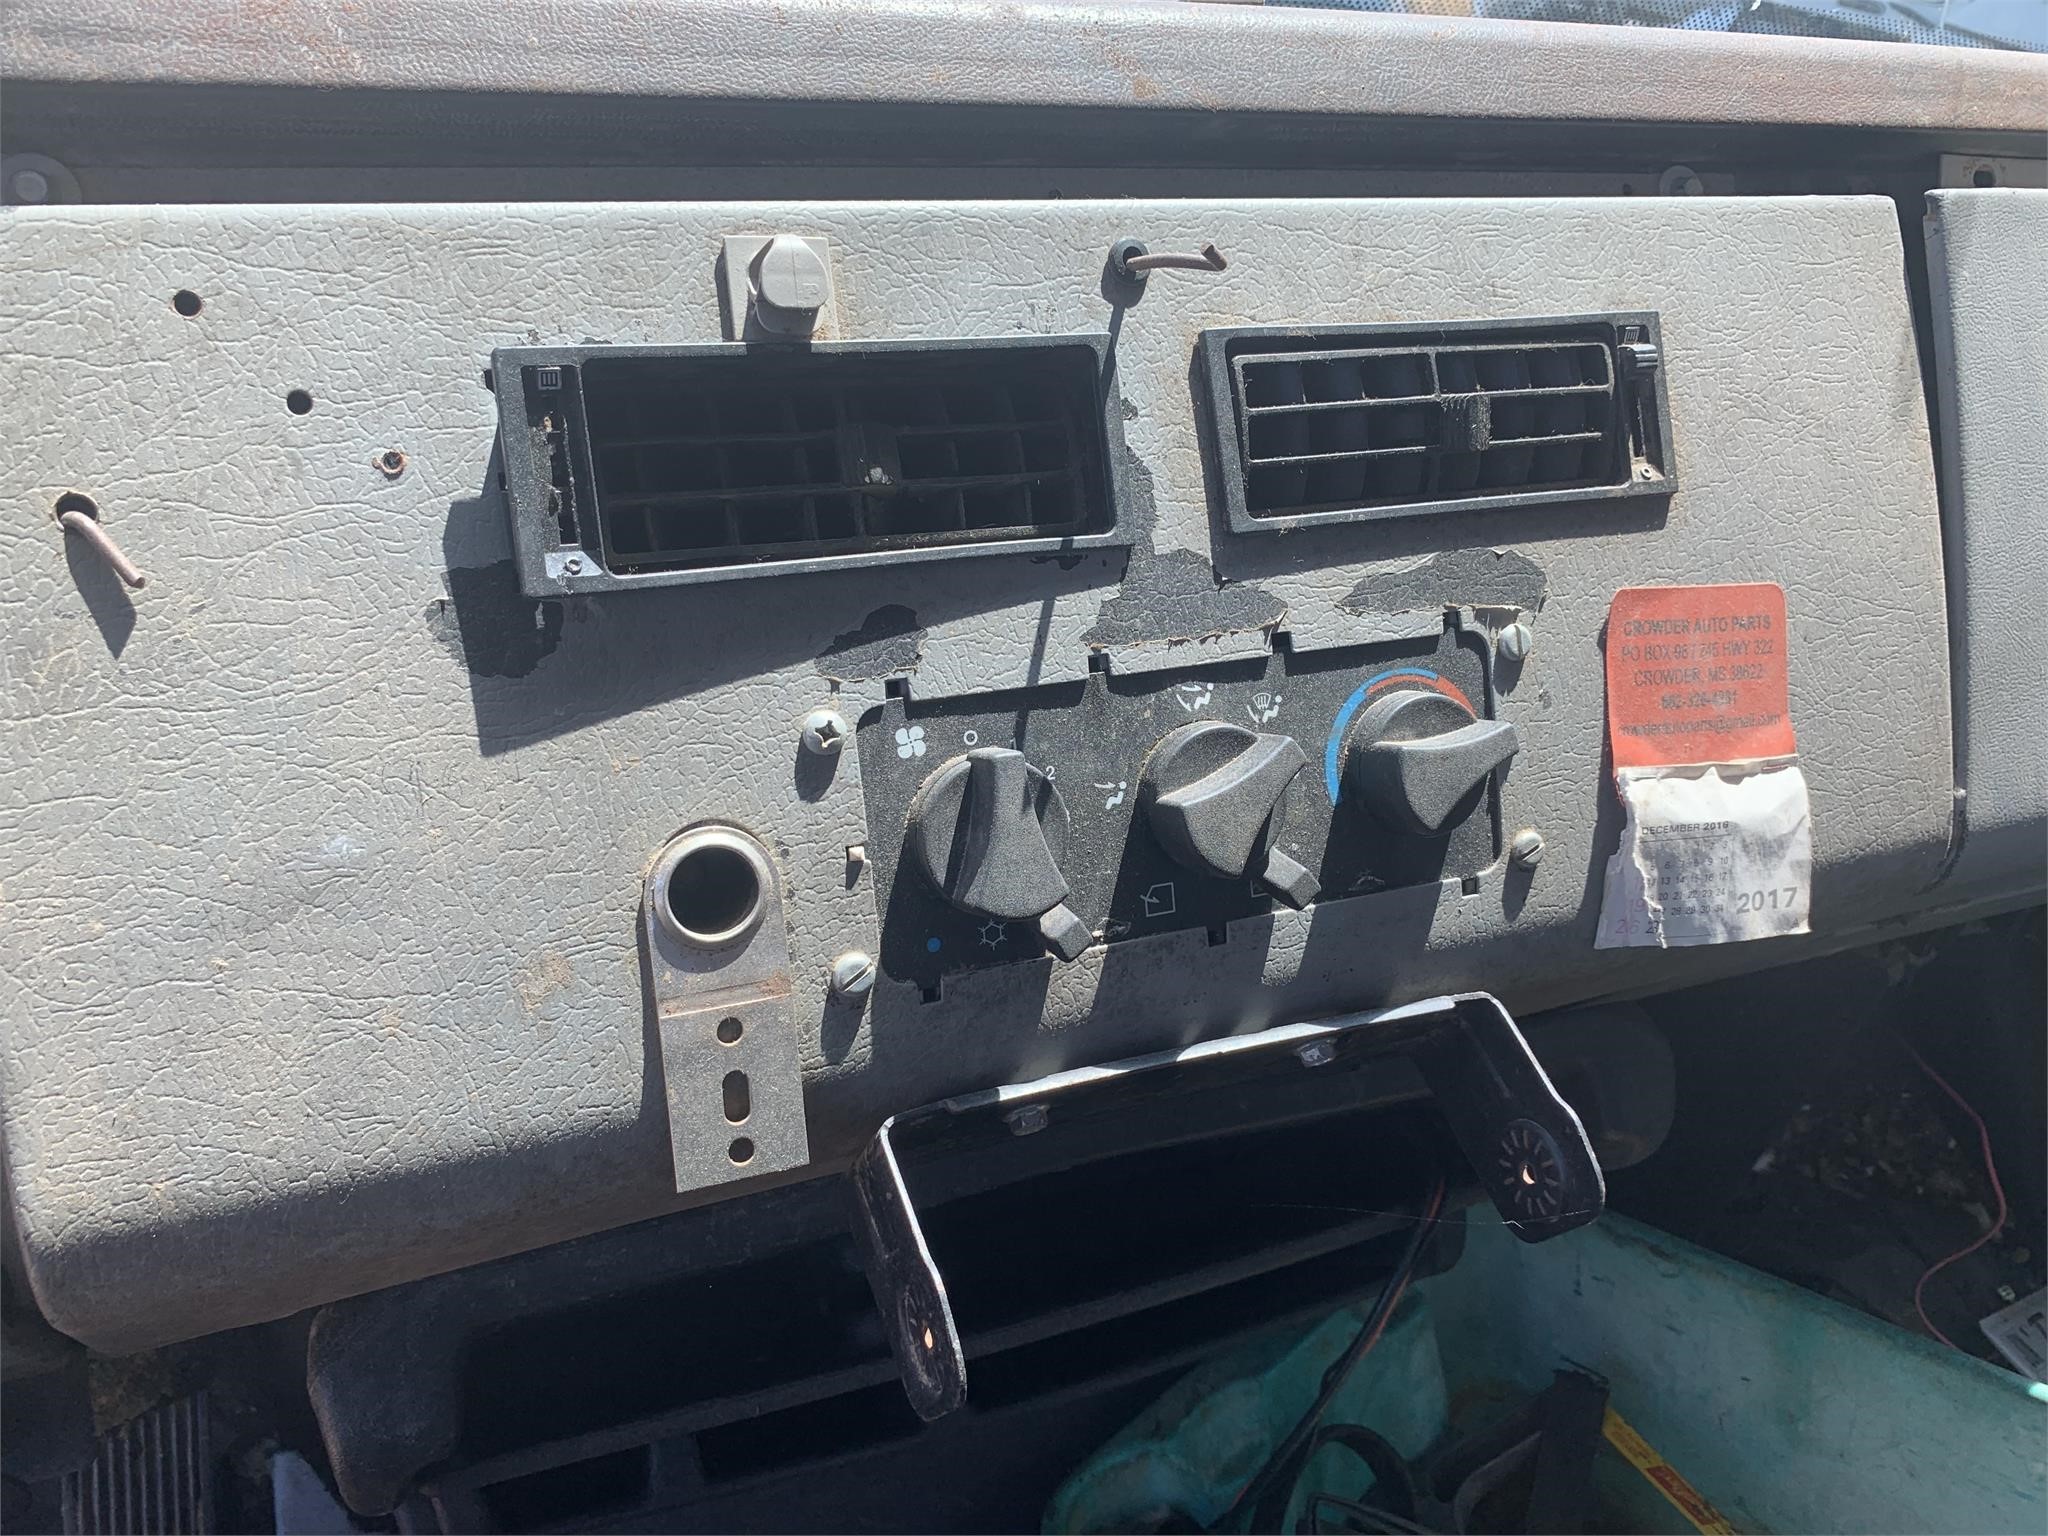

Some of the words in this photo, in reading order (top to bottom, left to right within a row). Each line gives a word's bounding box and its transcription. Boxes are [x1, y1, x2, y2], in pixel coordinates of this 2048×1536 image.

[1693, 617, 1729, 634] AUTO
[1732, 614, 1771, 632] PARTS
[1645, 642, 1671, 661] BOX
[1045, 765, 1056, 781] 2
[1641, 823, 1700, 836] DECEMBER
[1703, 820, 1729, 831] 2016
[1736, 886, 1798, 915] 2017
